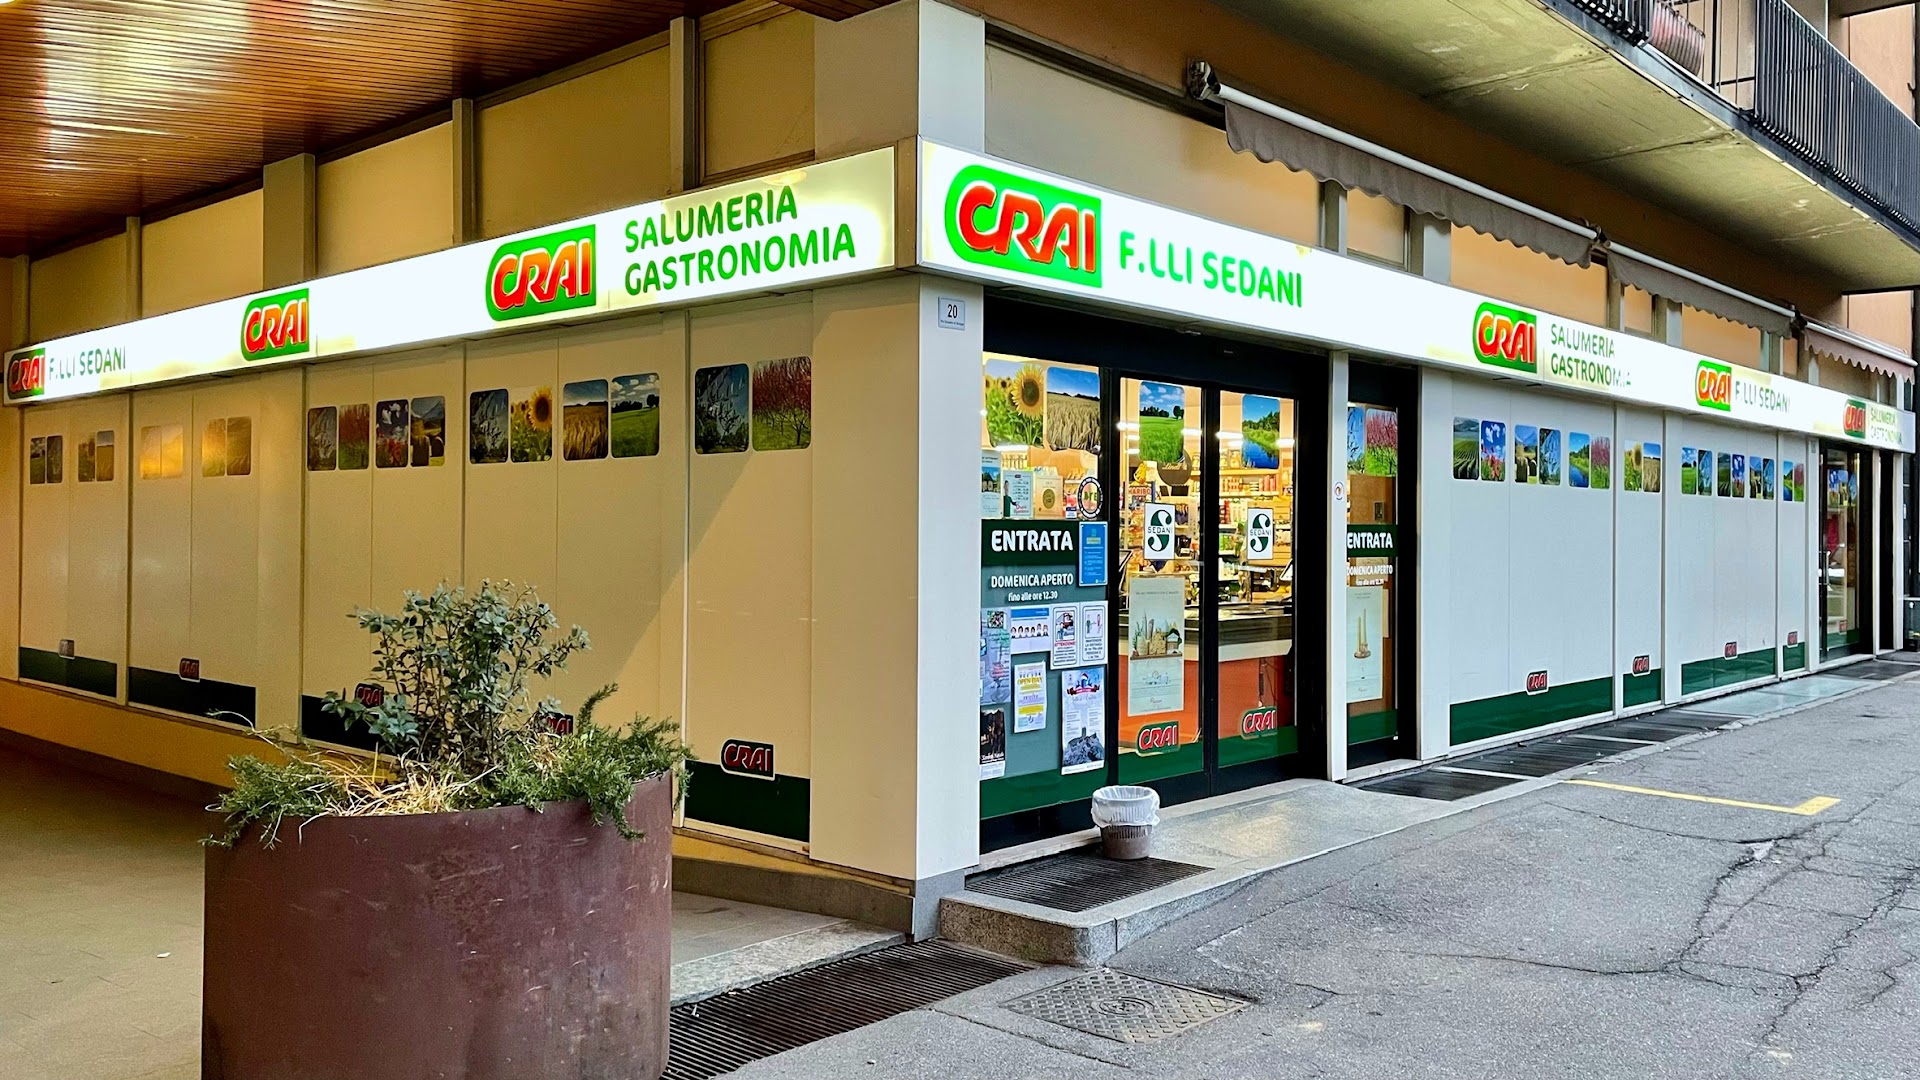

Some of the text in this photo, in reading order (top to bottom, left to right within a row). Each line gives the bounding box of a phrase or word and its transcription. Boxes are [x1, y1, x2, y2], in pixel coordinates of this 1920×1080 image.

[625, 184, 798, 253] SALUMERIA
[957, 181, 1096, 273] CRAI
[624, 223, 856, 296] GASTRONOMIA
[1119, 231, 1303, 308] F.LLI SEDANI
[491, 237, 591, 311] CRAI
[947, 304, 958, 318] 20
[244, 298, 308, 353] CRAI
[1476, 310, 1535, 364] CRAI
[1550, 323, 1615, 359] SALUMERIA
[9, 354, 46, 393] CRAI
[79, 345, 126, 376] SEDANI
[1697, 366, 1732, 406] CRAI
[1759, 386, 1791, 413] SEDANI
[1128, 487, 1152, 495] HARIBO
[991, 530, 1074, 552] ENTRATA
[1147, 526, 1173, 534] SEDANI
[1347, 532, 1393, 549] ENTRATA
[991, 573, 1073, 588] DOMENICA APERTO
[1374, 564, 1393, 575] APERTO
[1008, 590, 1058, 602] fino alle ore 12.30
[356, 686, 383, 707] CRAI
[543, 715, 573, 736] RAI
[1243, 710, 1277, 734] CRAI
[1138, 724, 1177, 750] CRAI
[724, 743, 772, 772] CRAI
